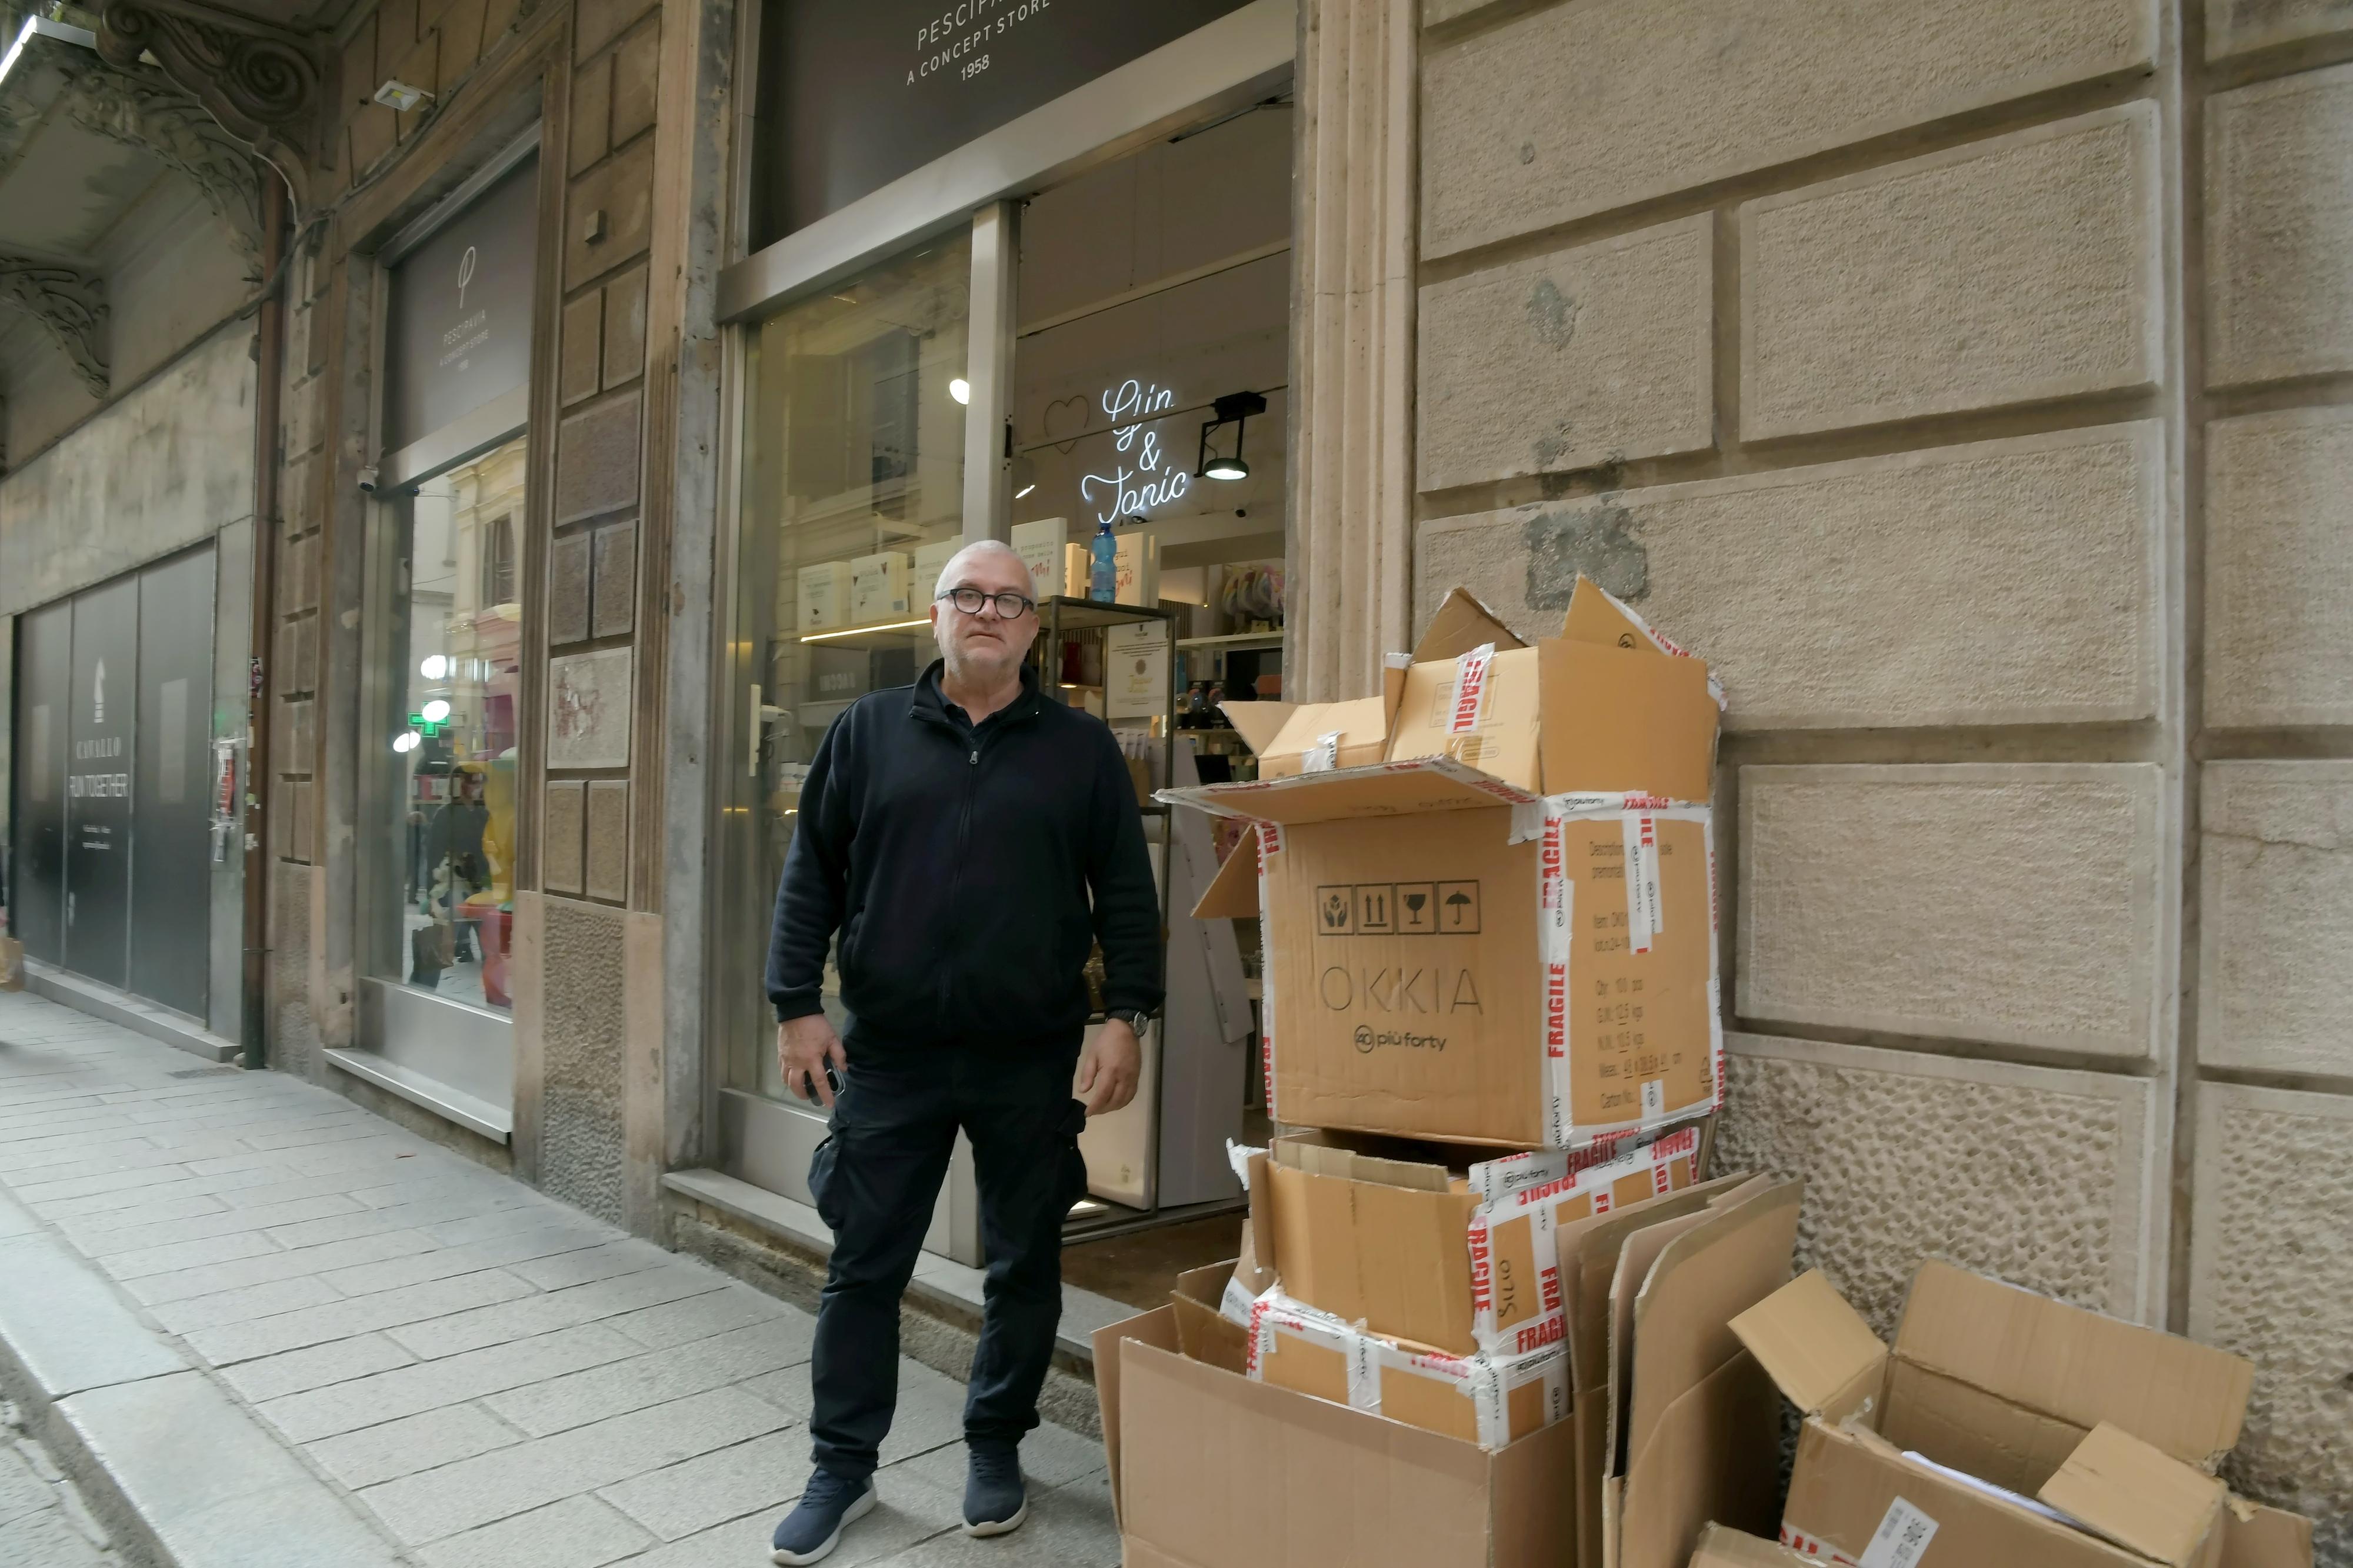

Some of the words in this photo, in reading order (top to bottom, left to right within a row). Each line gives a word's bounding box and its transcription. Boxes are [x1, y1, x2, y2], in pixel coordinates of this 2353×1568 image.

[906, 70, 915, 86] A
[920, 24, 991, 77] CONCEPT
[997, 0, 1050, 34] STORE
[918, 0, 1001, 51] PESCIP
[961, 54, 990, 81] 1958
[1139, 431, 1161, 471] &
[1081, 466, 1187, 523] Tonic
[1452, 660, 1484, 734] FRAGIL
[1321, 966, 1484, 1015] OKKIA
[1548, 963, 1565, 1057] FRAGILE
[1567, 1140, 1617, 1175] FRAGILE
